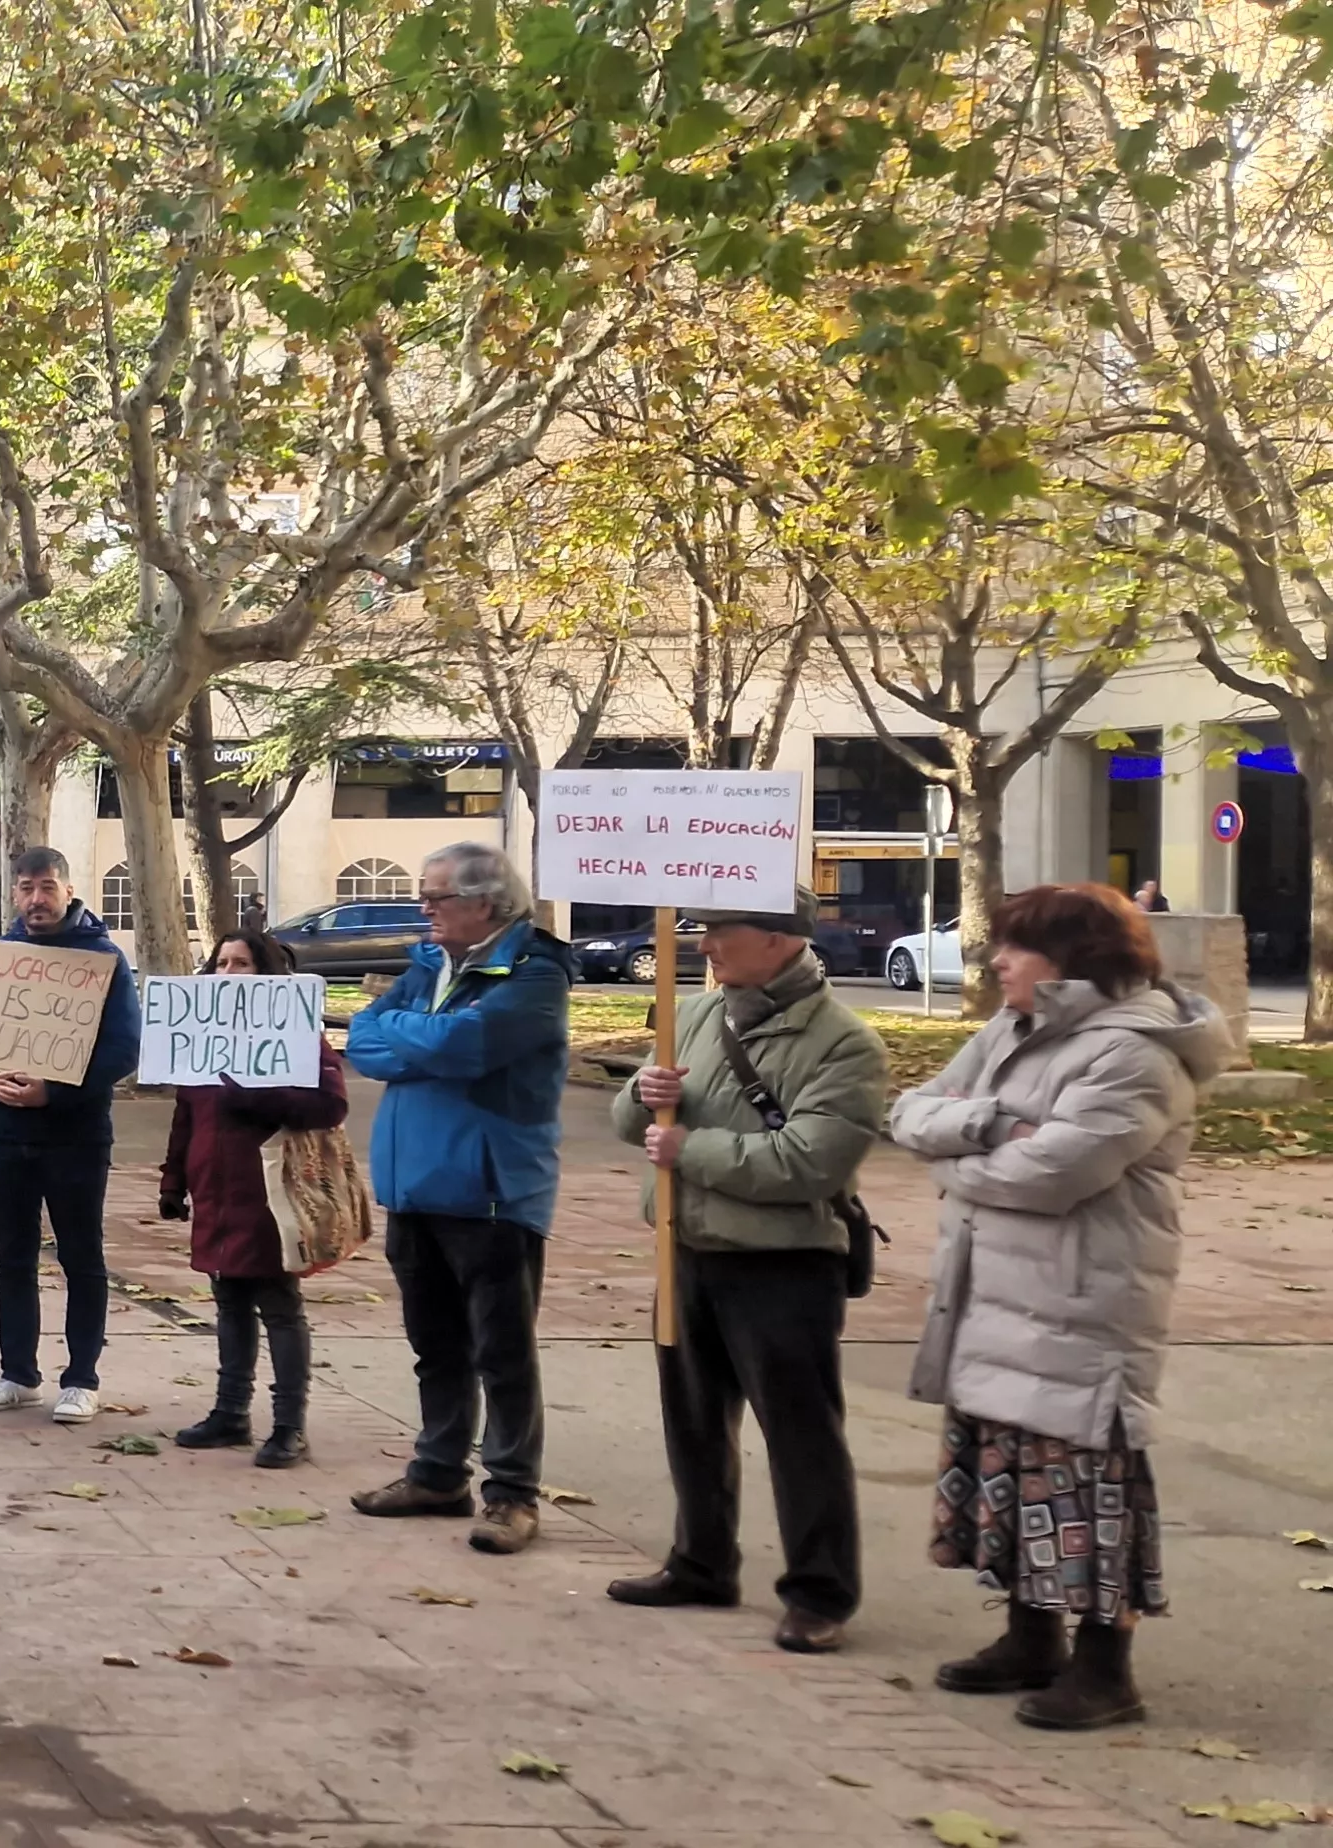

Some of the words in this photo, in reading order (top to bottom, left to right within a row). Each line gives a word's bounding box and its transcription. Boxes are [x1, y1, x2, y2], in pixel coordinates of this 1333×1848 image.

[552, 784, 592, 797] PORQUE
[611, 786, 628, 797] NO
[723, 786, 791, 798] QUEREMOS
[556, 814, 624, 834] DEJAR
[646, 815, 670, 834] LA
[578, 857, 648, 876] HECHA
[1, 985, 32, 1021] ES
[33, 992, 96, 1026] SOLO
